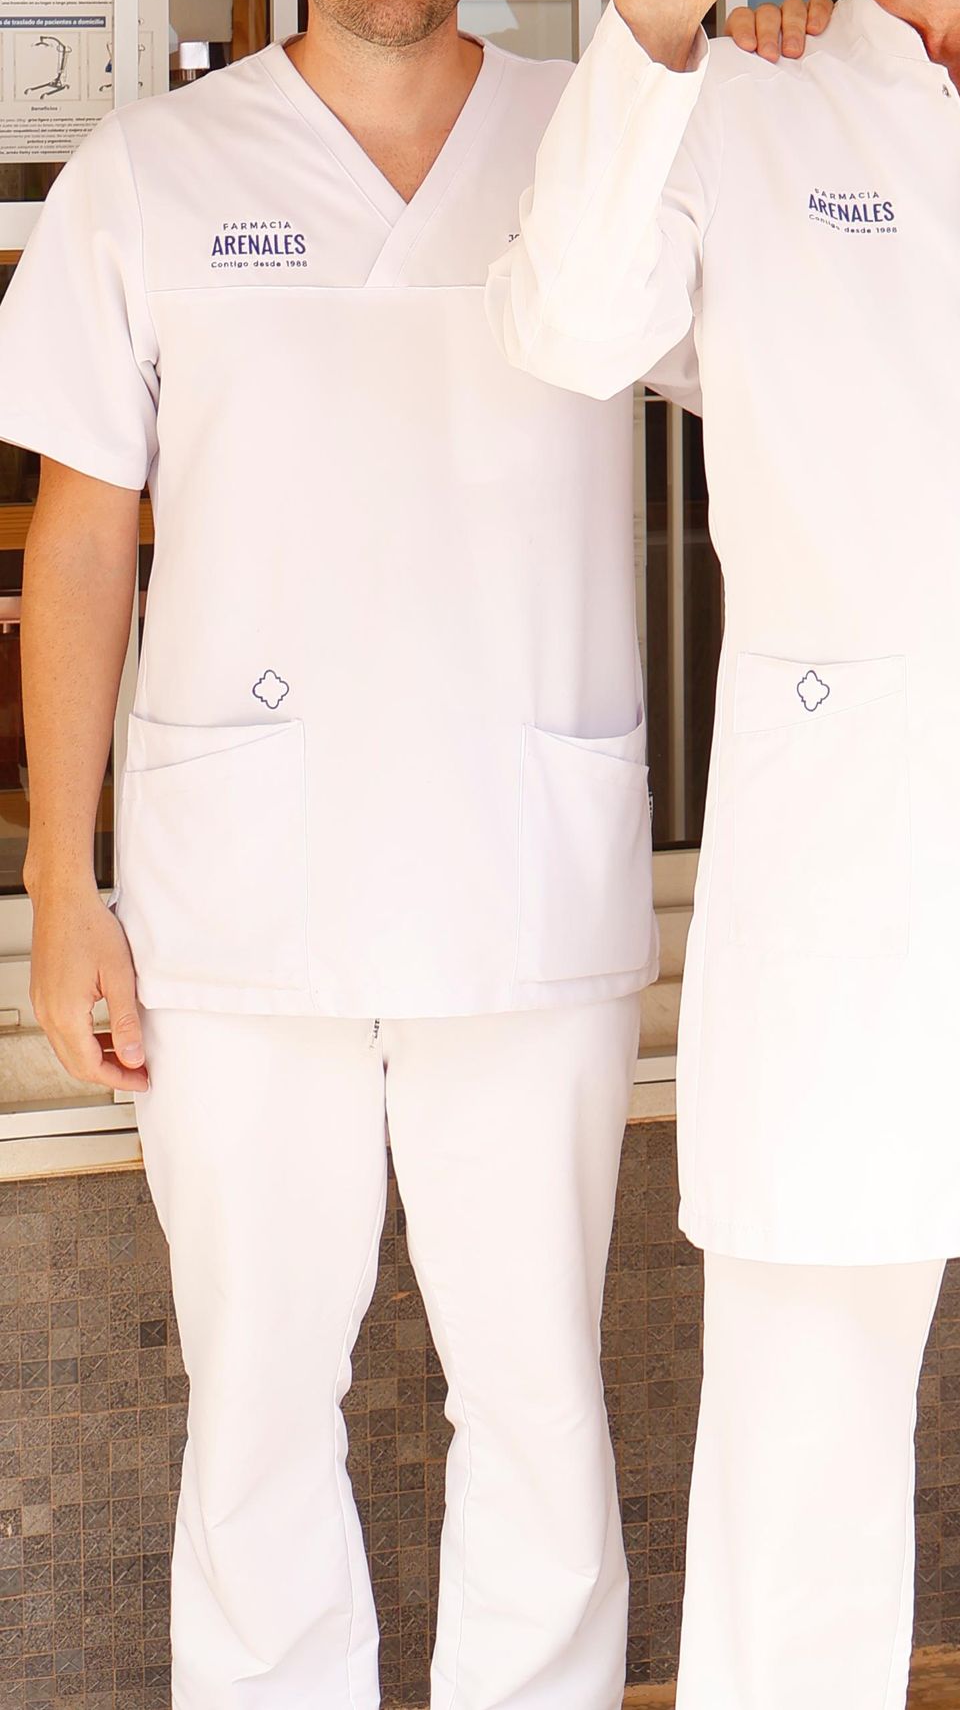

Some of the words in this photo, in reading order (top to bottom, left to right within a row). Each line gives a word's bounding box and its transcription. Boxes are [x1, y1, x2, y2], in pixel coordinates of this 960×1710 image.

[814, 188, 880, 200] FARMACIA
[808, 194, 894, 223] ARENALES
[223, 221, 291, 230] FARMACIA
[211, 234, 306, 256] ARENALES
[253, 260, 281, 268] desde
